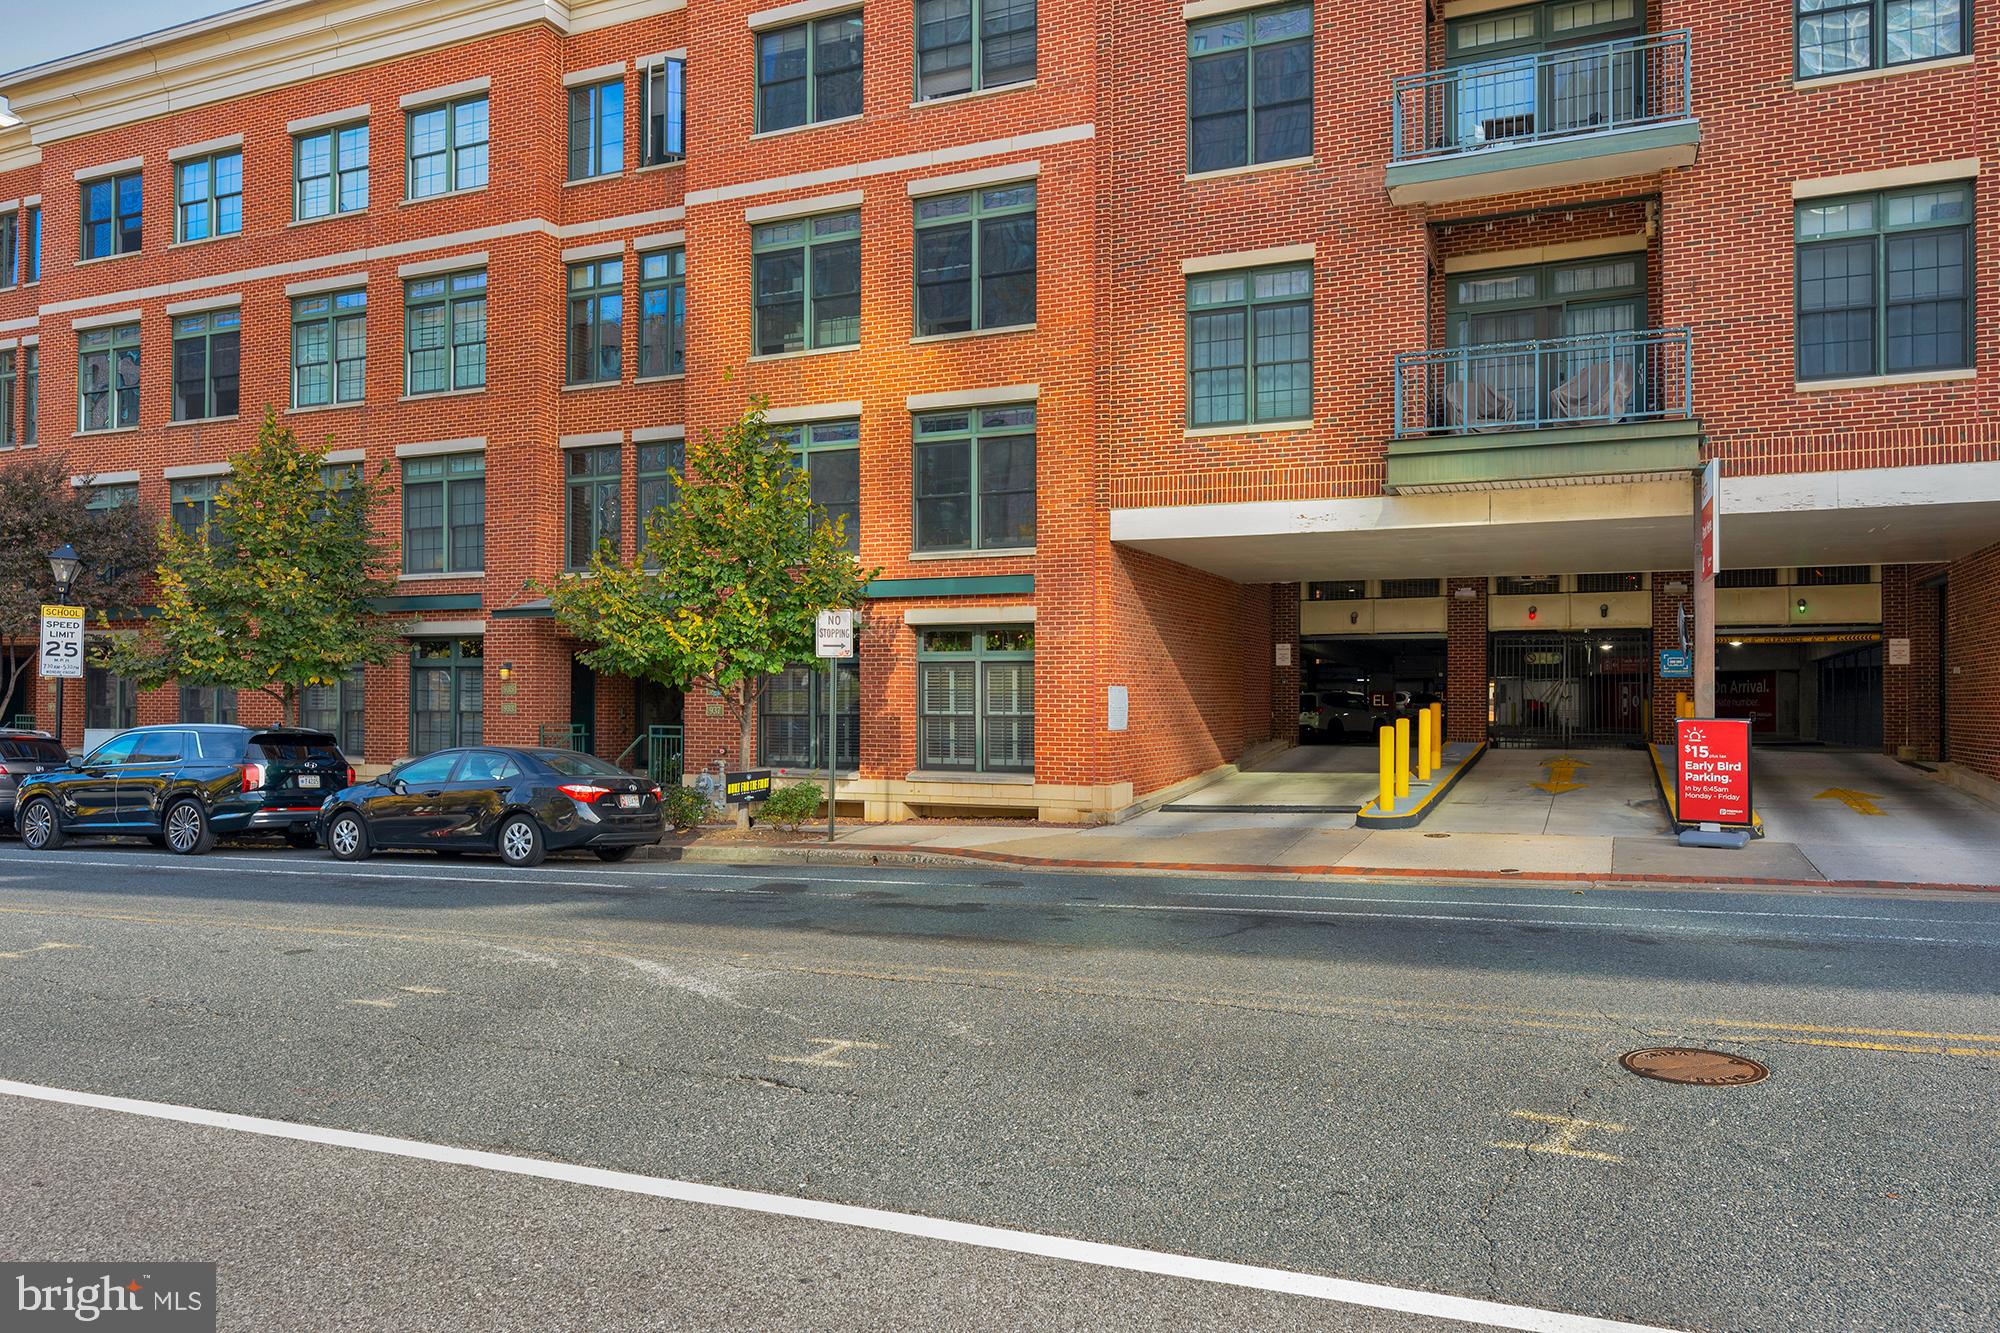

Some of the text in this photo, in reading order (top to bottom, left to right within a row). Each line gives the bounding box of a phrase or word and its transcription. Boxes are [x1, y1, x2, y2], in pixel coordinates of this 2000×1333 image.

[46, 608, 80, 617] SCHOOL
[46, 620, 80, 629] SPEED
[828, 615, 841, 625] NO
[50, 630, 75, 638] LIMIT
[819, 628, 850, 638] STOPPING
[45, 641, 78, 658] 25
[1373, 694, 1389, 706] EL
[1684, 744, 1709, 758] $15
[1685, 761, 1742, 772] Early Bird
[1685, 772, 1732, 784] Parking.
